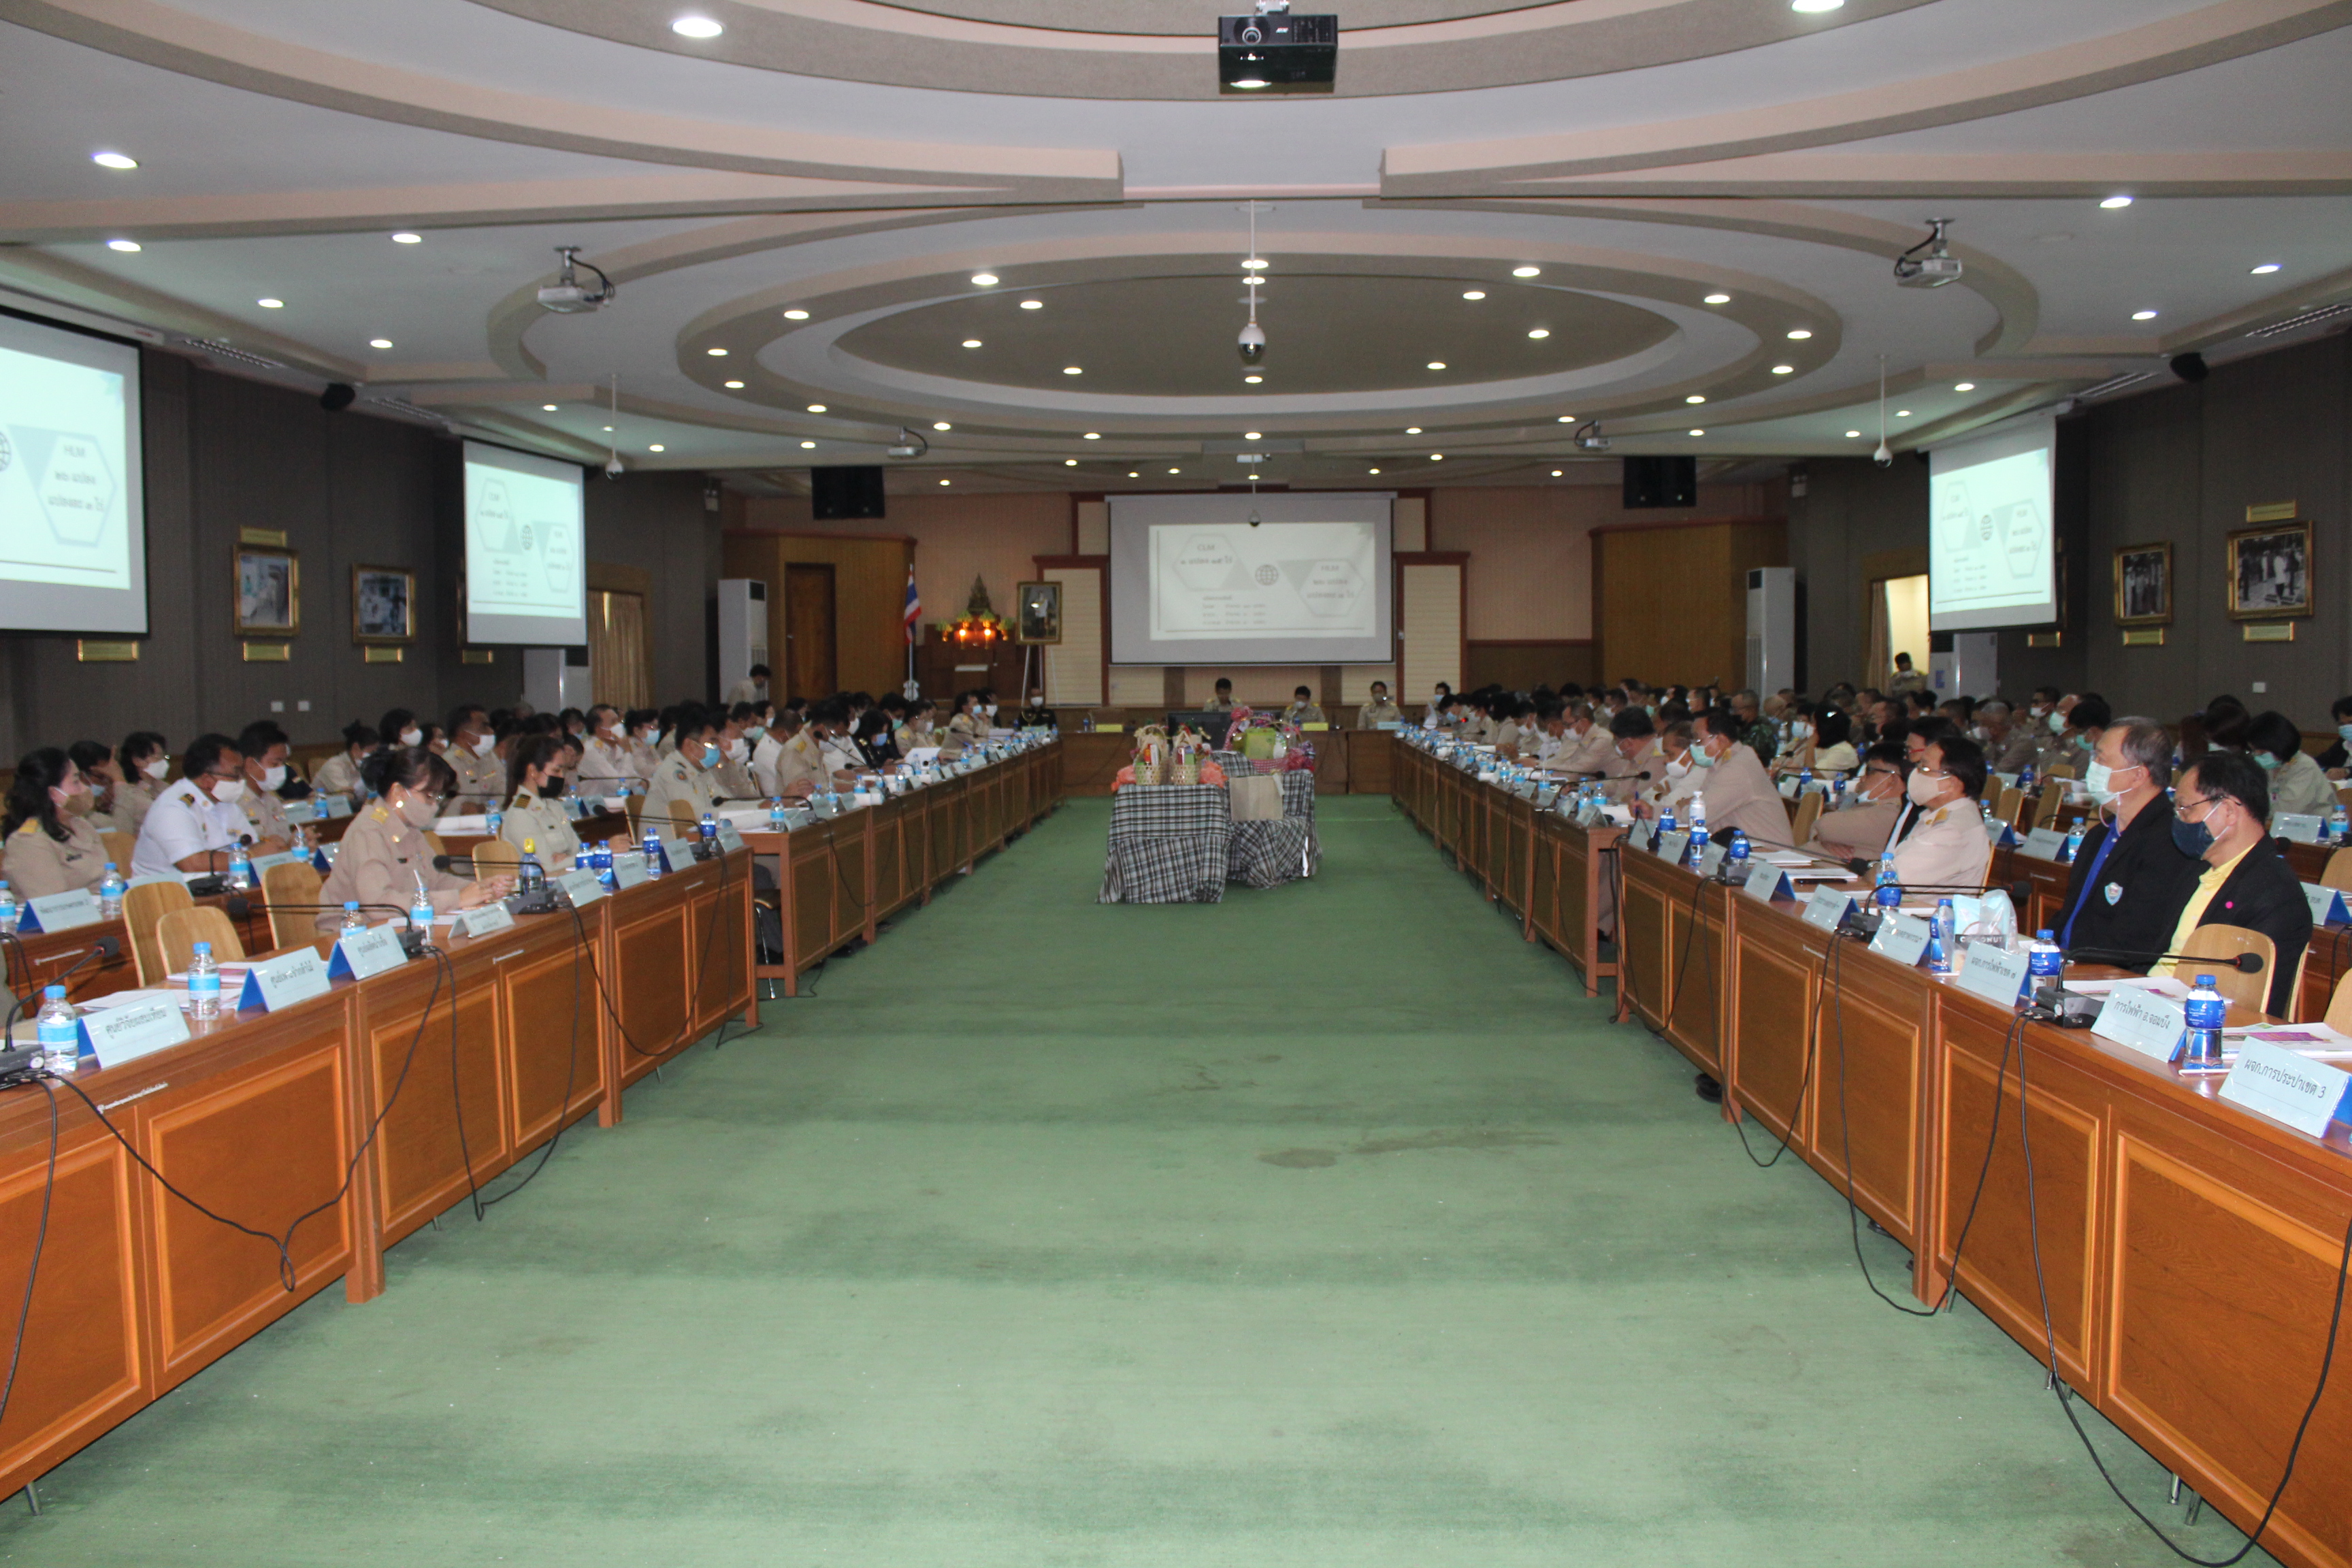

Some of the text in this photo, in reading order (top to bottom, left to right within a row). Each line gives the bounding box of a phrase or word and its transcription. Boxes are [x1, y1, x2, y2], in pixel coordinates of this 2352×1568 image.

[2113, 1000, 2142, 1020] การไฟฟ้า
[2142, 1012, 2171, 1029] อ.จอมบึง
[2244, 1058, 2327, 1098] ผจก.การประปาเขต 3
